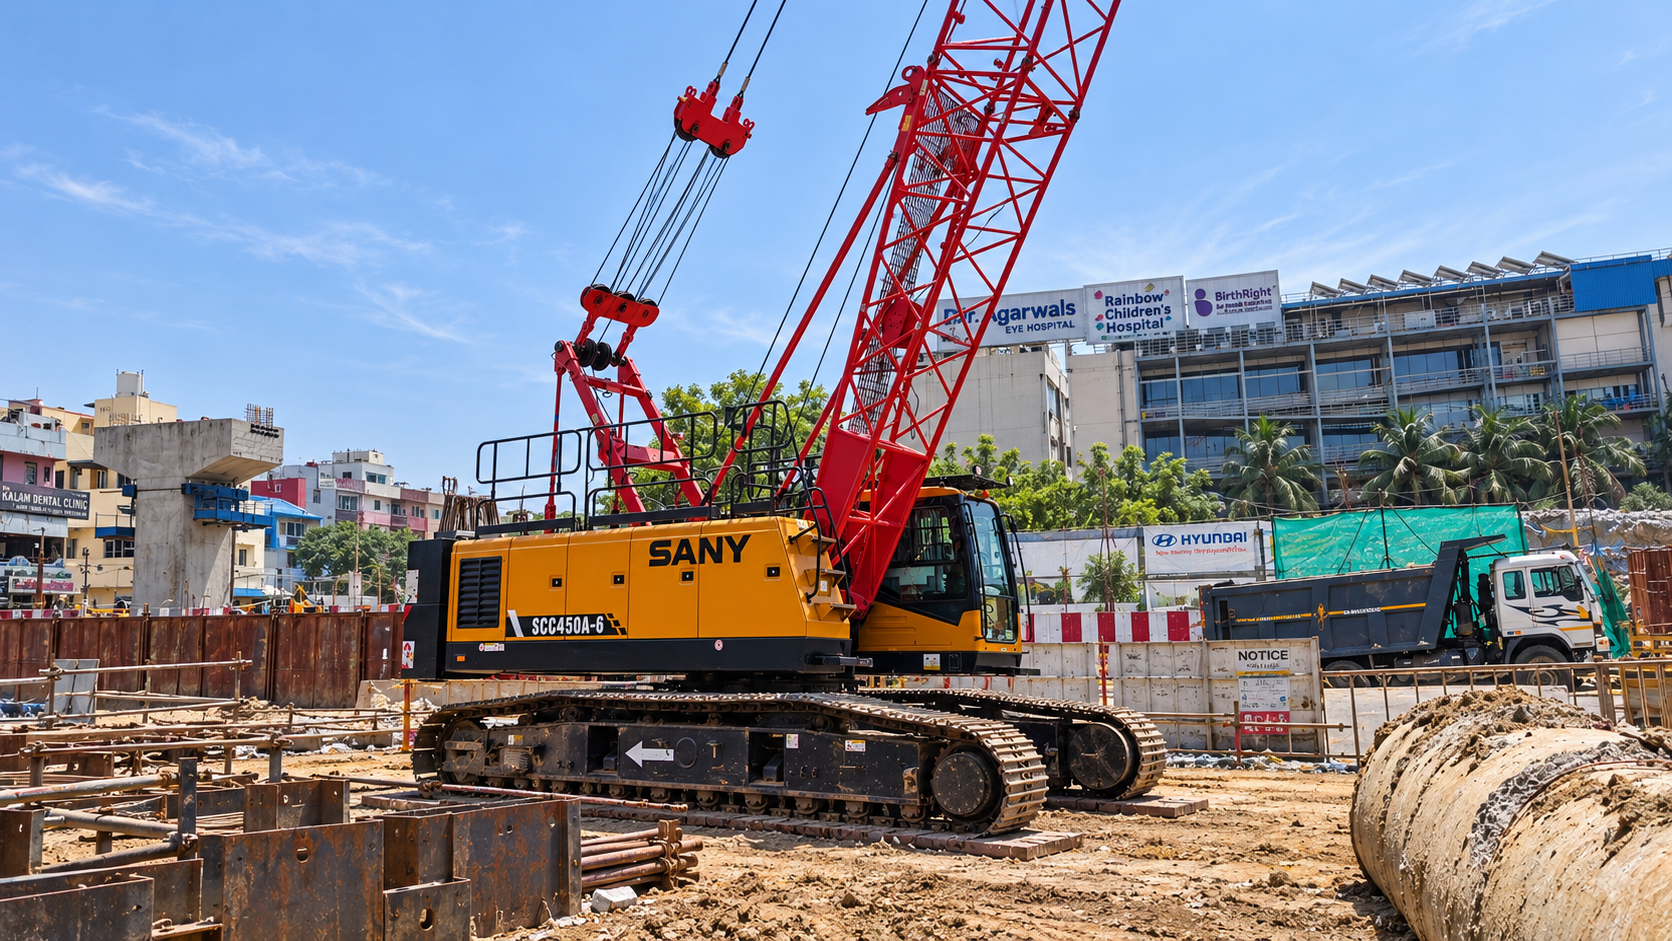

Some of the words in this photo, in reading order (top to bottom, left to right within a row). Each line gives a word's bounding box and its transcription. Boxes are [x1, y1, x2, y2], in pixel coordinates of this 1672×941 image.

[1105, 292, 1164, 307] Rainbow
[1215, 287, 1272, 301] BirthRight
[1105, 304, 1171, 320] Children's
[1005, 324, 1024, 334] EYE
[1027, 320, 1075, 332] HOSPITAL
[1106, 317, 1164, 333] Hospital
[2, 491, 31, 503] KALAM
[63, 498, 88, 510] CLINIC
[1181, 531, 1247, 545] HYUNDAI
[649, 535, 751, 567] SANY
[532, 616, 604, 635] SCC450A-6
[1238, 650, 1288, 661] NOTICE
